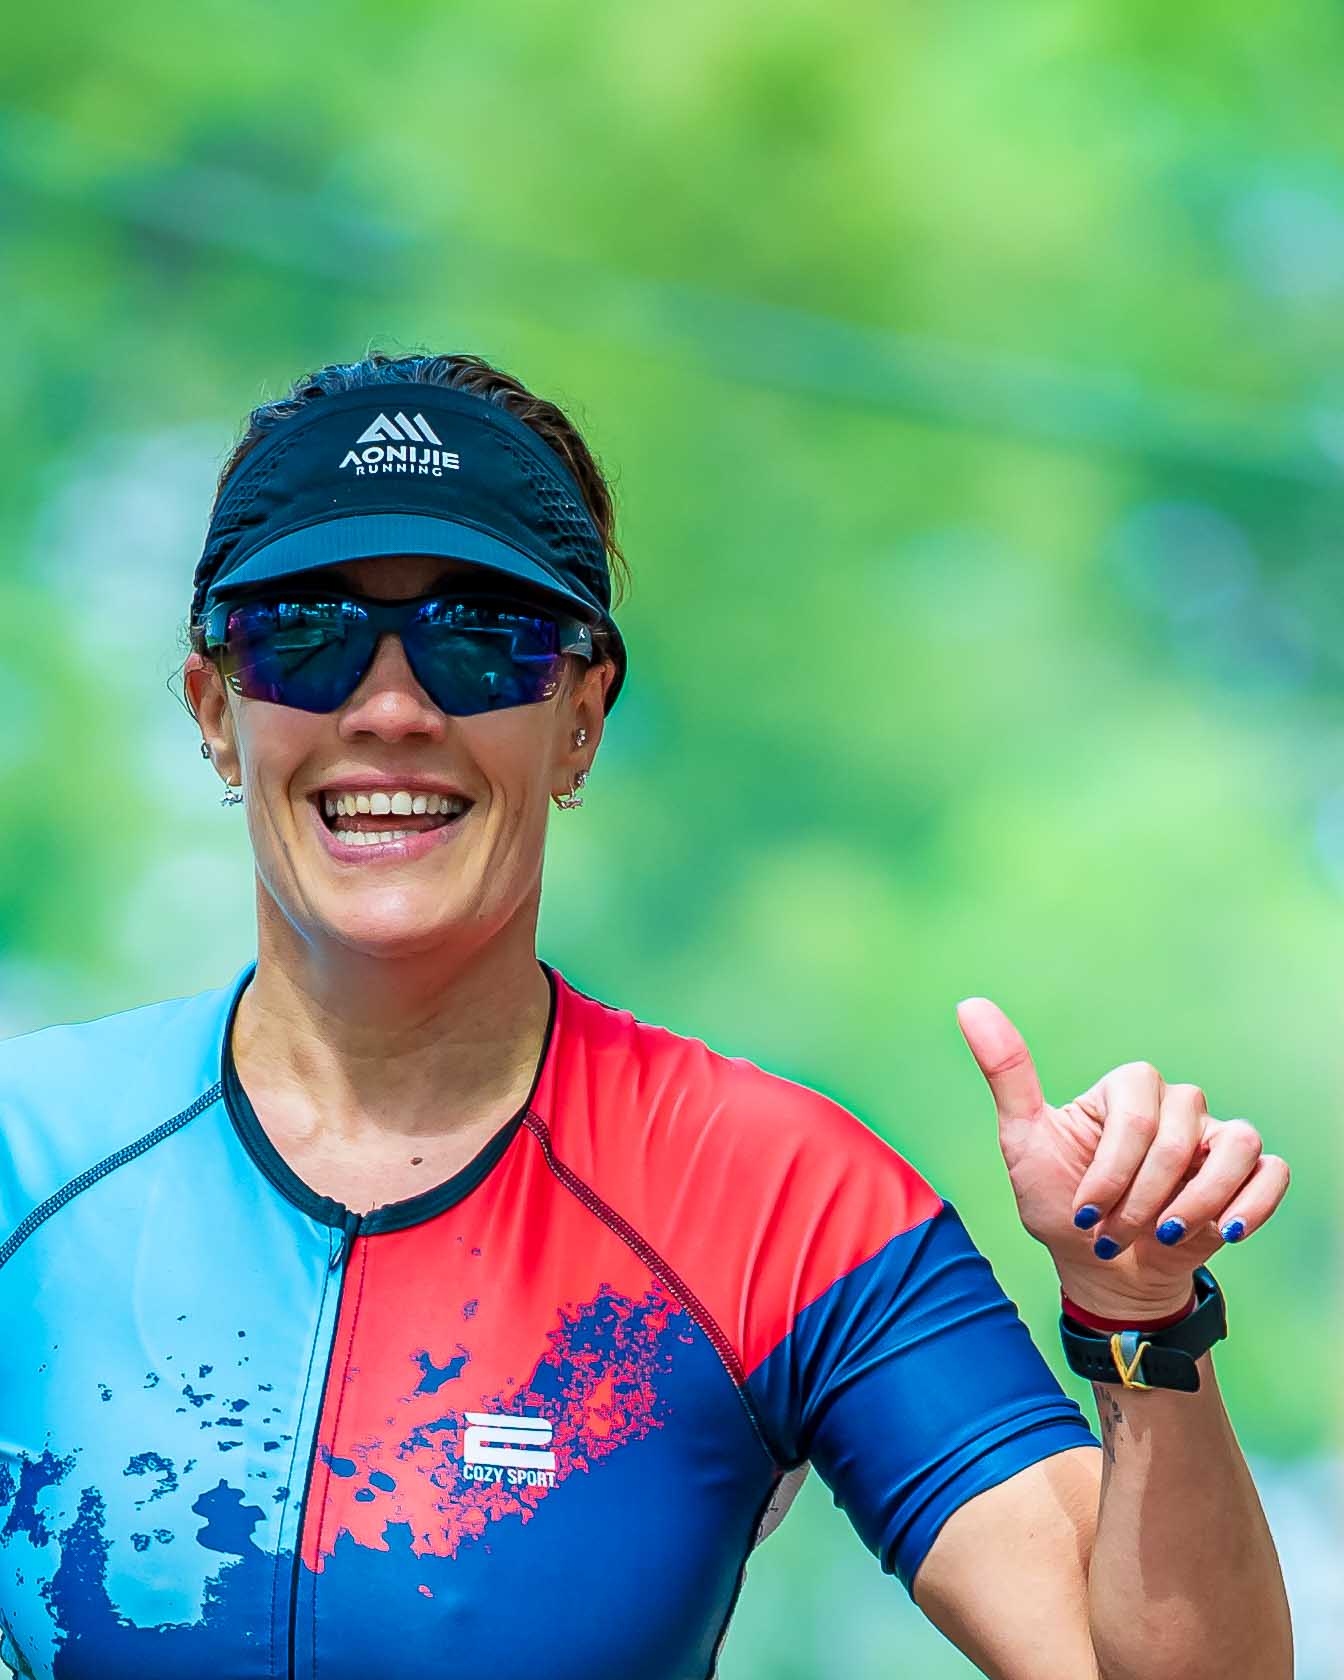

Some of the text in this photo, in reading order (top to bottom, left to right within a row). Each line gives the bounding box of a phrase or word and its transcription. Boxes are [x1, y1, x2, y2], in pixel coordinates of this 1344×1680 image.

[339, 446, 460, 470] AONIJIE
[356, 463, 443, 477] RUNNING
[463, 1465, 556, 1487] COZY SPORT
